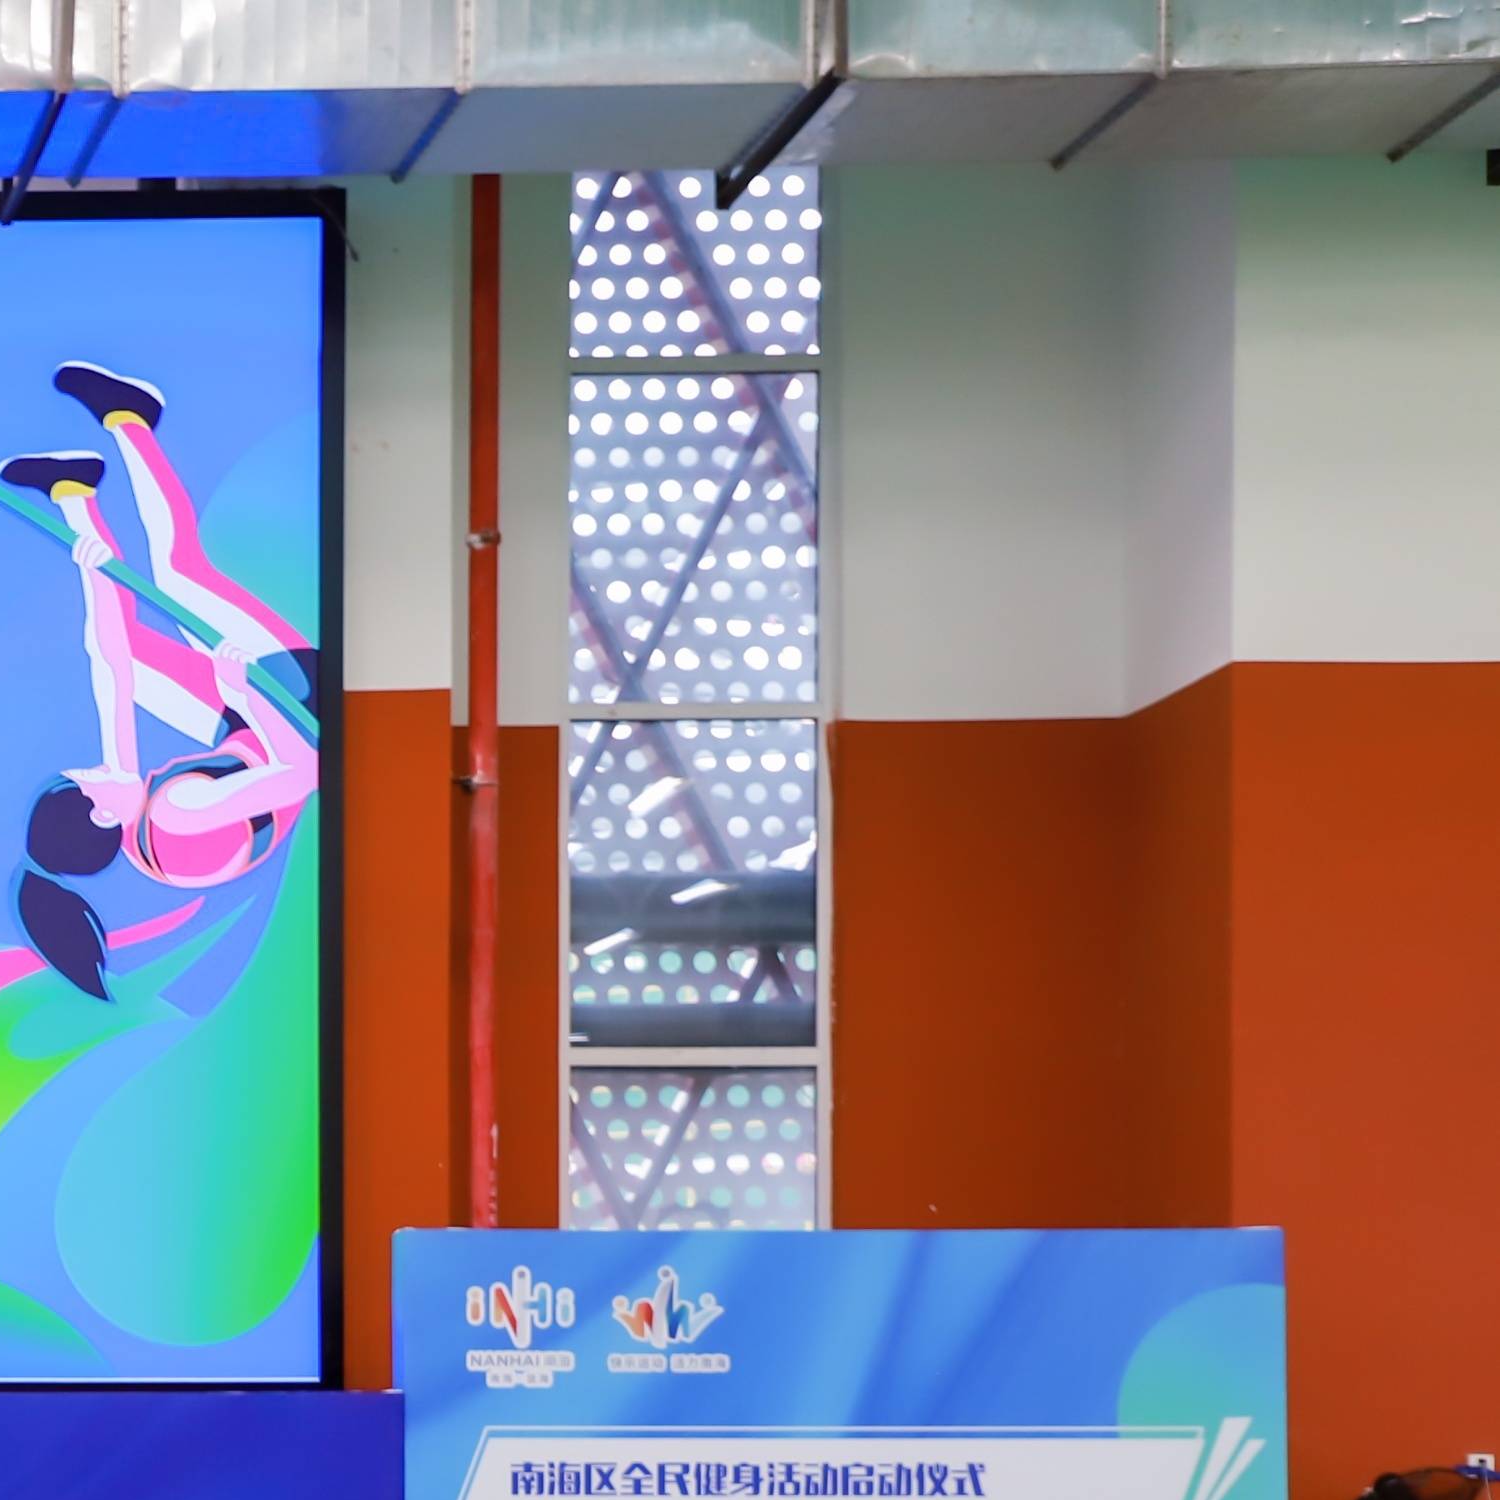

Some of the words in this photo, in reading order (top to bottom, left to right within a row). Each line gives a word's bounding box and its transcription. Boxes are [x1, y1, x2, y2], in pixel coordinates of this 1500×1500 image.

[467, 1352, 540, 1370] NANHAI
[510, 1462, 986, 1498] 南海区全民健身活动启动仪式
